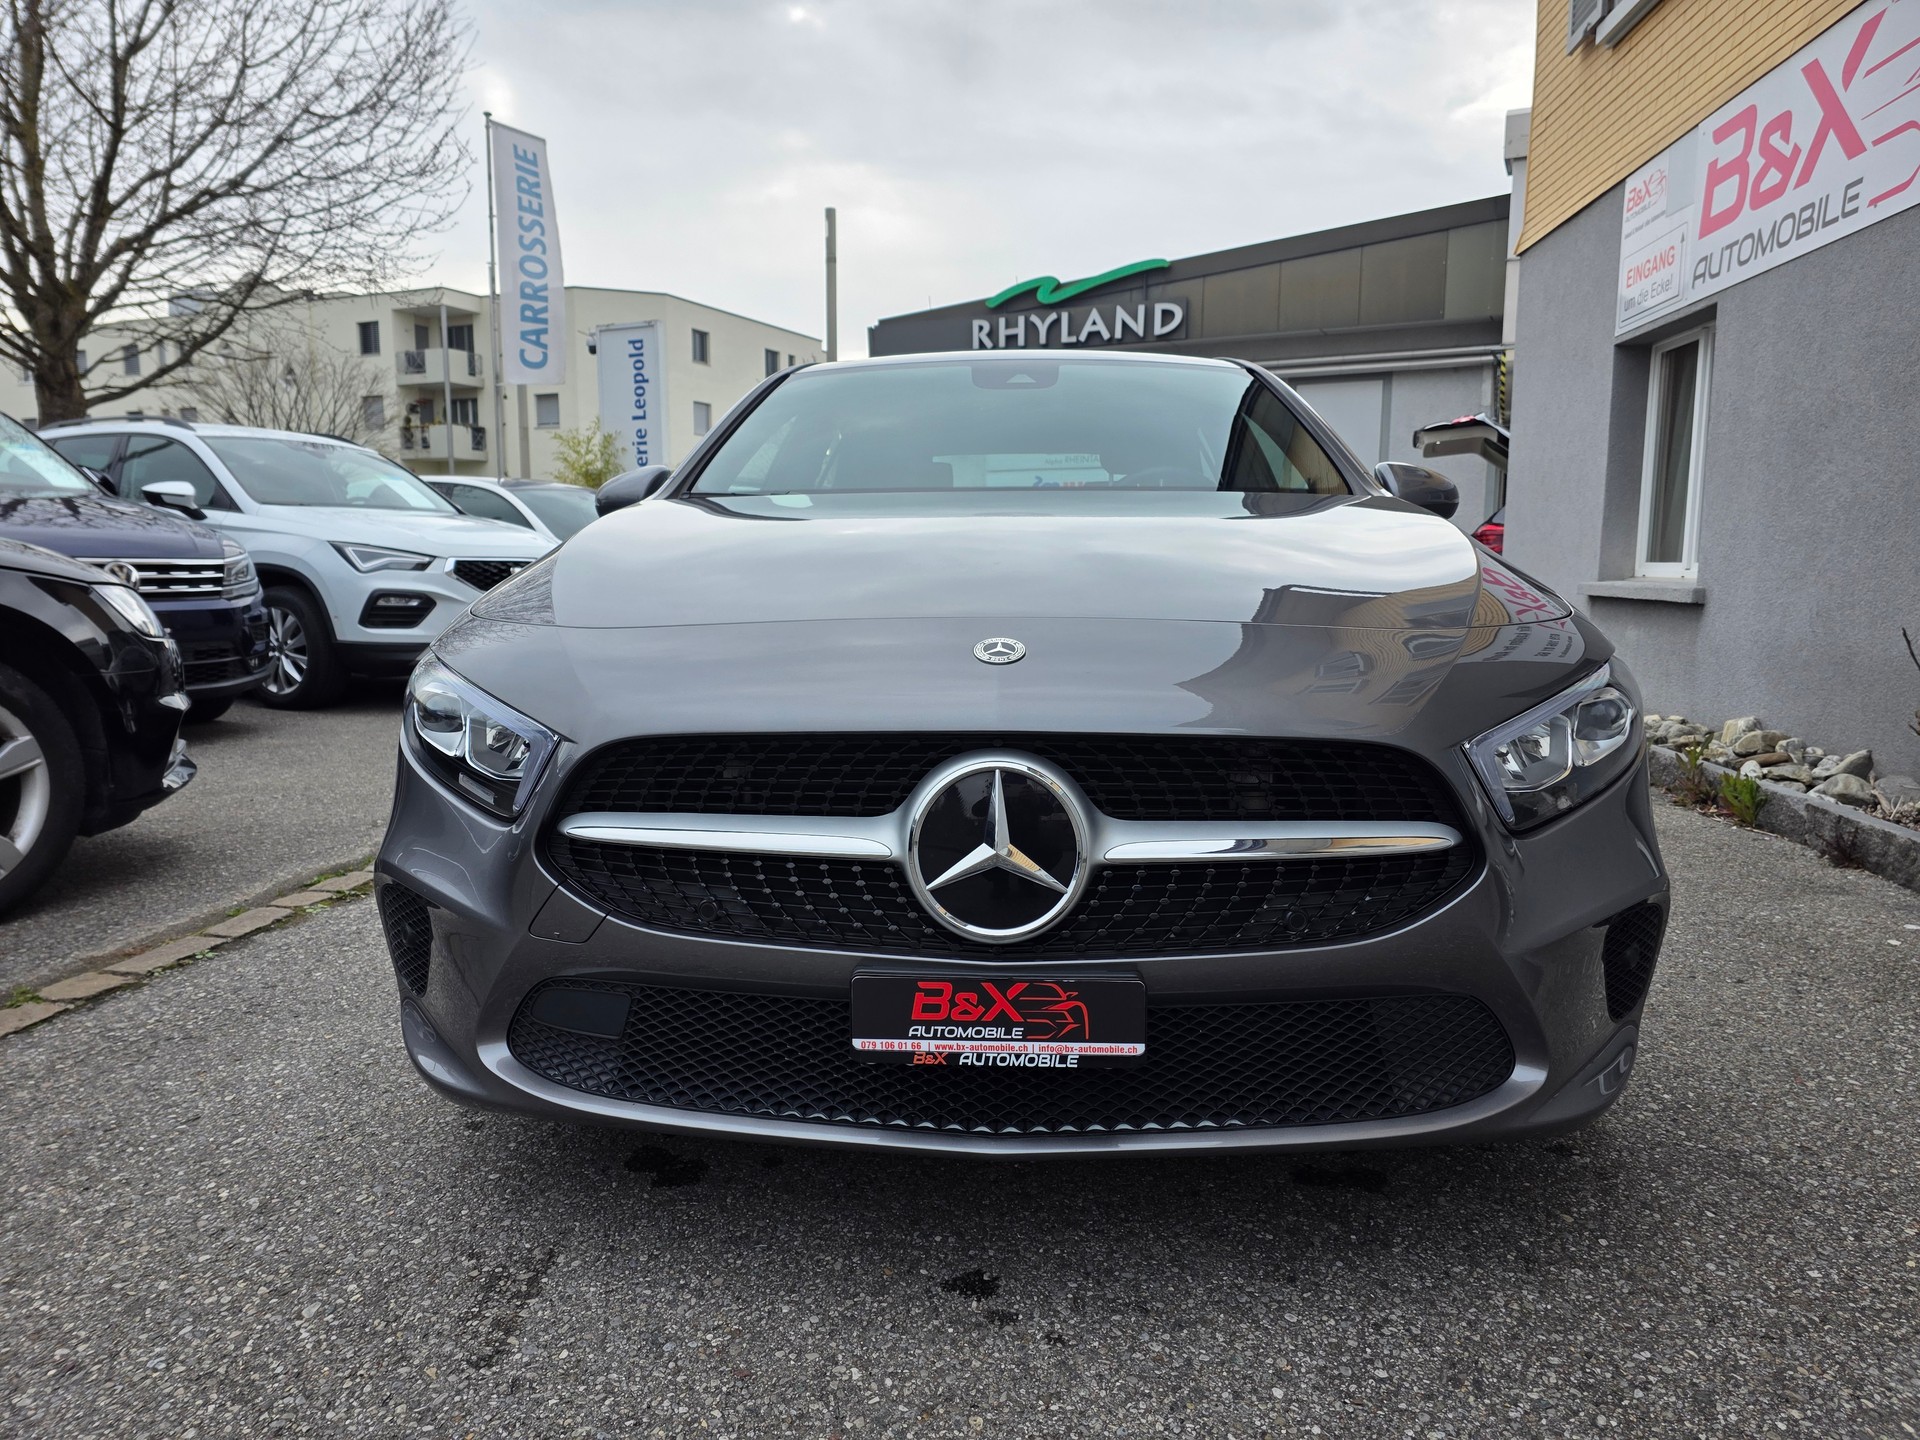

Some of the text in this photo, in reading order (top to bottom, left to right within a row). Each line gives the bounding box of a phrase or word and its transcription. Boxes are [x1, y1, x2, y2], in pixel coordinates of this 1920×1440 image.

[1698, 7, 1888, 240] B&X
[1692, 177, 1864, 289] AUTOMOBILE
[512, 144, 549, 370] CARROSSERIE
[1626, 245, 1675, 289] EINGANG
[1624, 273, 1674, 312] um die Ecke!
[972, 303, 1184, 350] RHYLAND
[628, 339, 649, 421] Leopold
[911, 981, 1030, 1022] B&X
[861, 1041, 1138, 1054] 079 106 01 66 www.bx-automobile.ch info@bx-automobile.ch
[908, 1026, 1024, 1039] AUTOMOBILE
[913, 1051, 1079, 1067] B&X AUTOMOBILE
